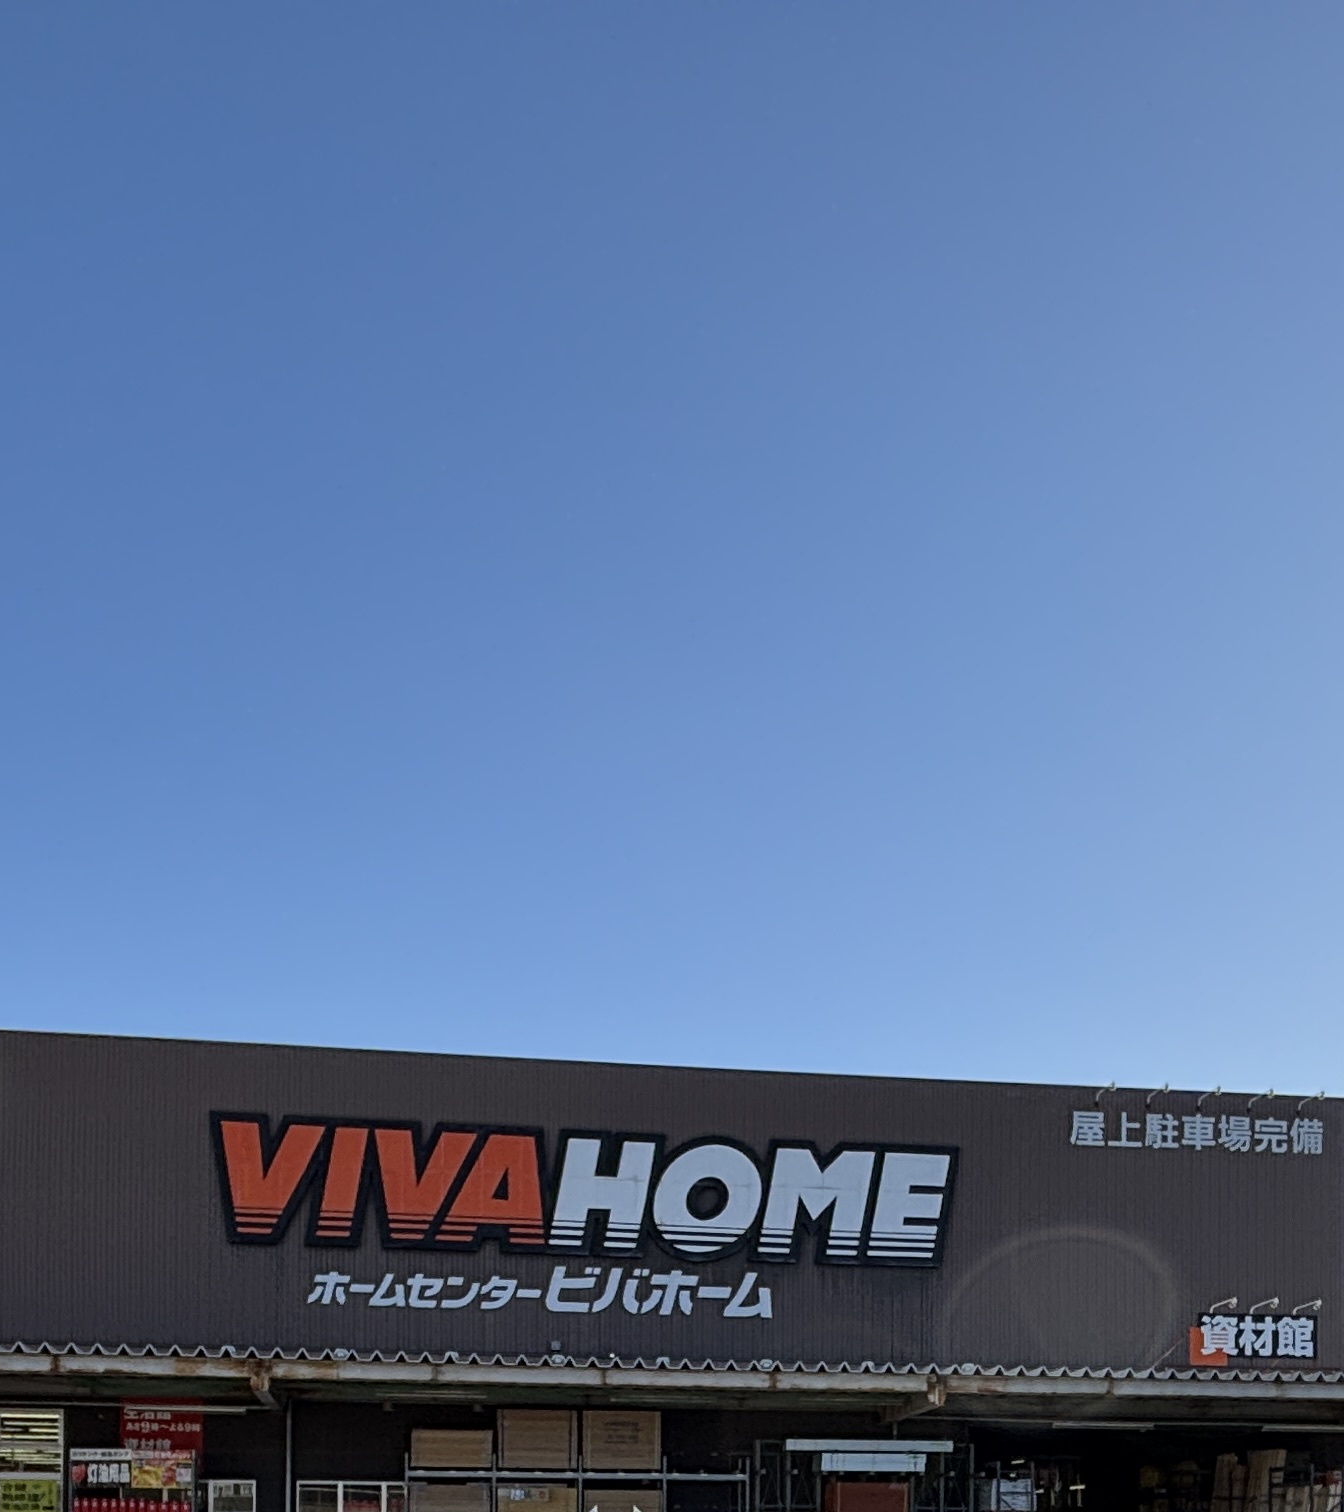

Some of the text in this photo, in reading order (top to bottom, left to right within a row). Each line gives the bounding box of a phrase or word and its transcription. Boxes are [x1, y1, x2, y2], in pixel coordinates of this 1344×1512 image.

[1069, 1111, 1325, 1155] 屋上駐車場完備
[216, 1116, 954, 1263] VIVAHOME
[307, 1266, 773, 1319] ホームセンタービバホーム
[1198, 1314, 1317, 1359] 資材館
